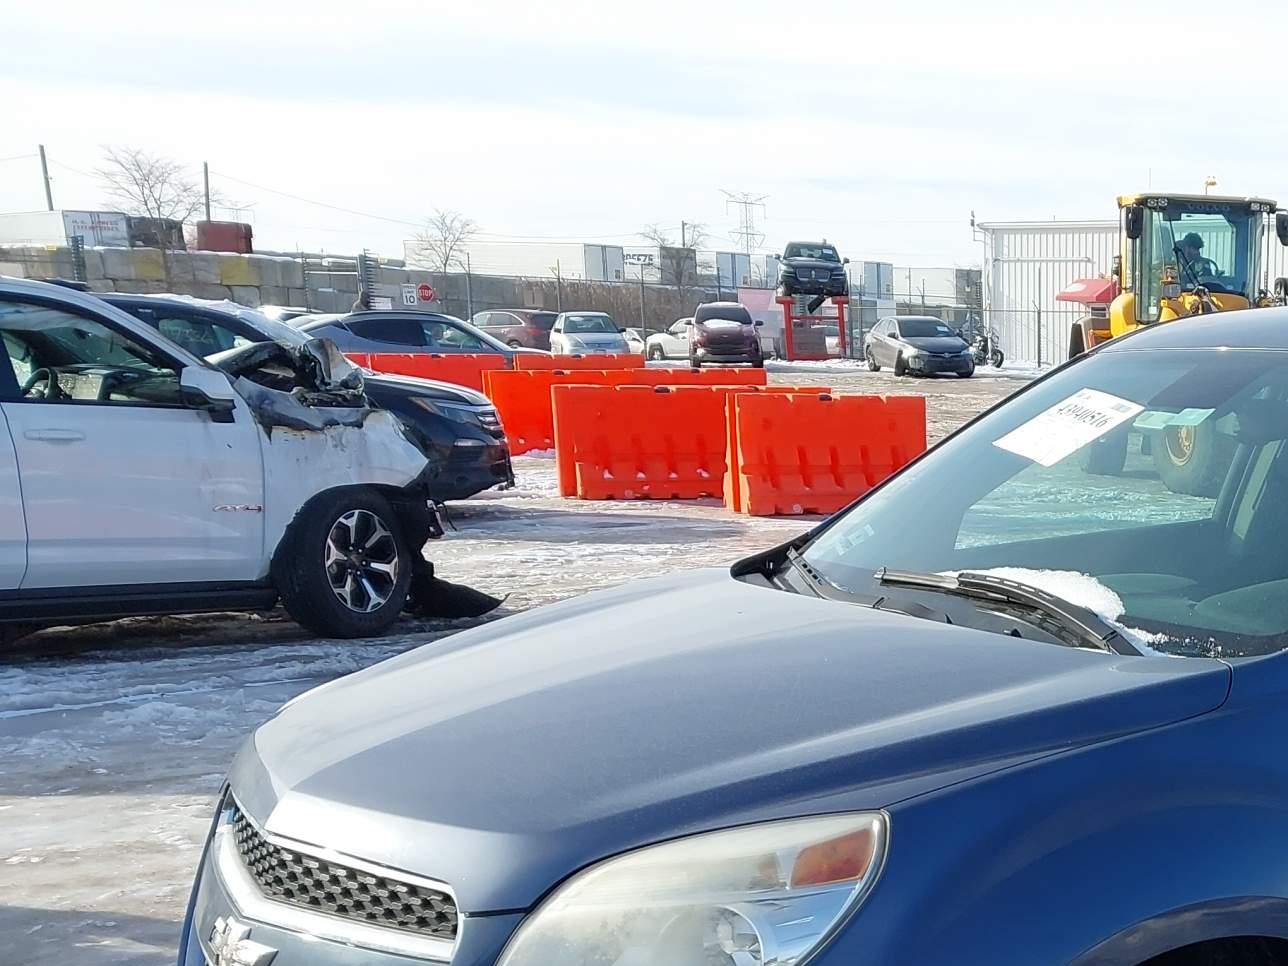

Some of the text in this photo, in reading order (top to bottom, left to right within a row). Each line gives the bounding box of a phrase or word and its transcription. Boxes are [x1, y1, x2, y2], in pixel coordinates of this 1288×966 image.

[418, 289, 432, 297] STOP
[405, 295, 416, 304] 10
[1057, 402, 1114, 429] 43940516
